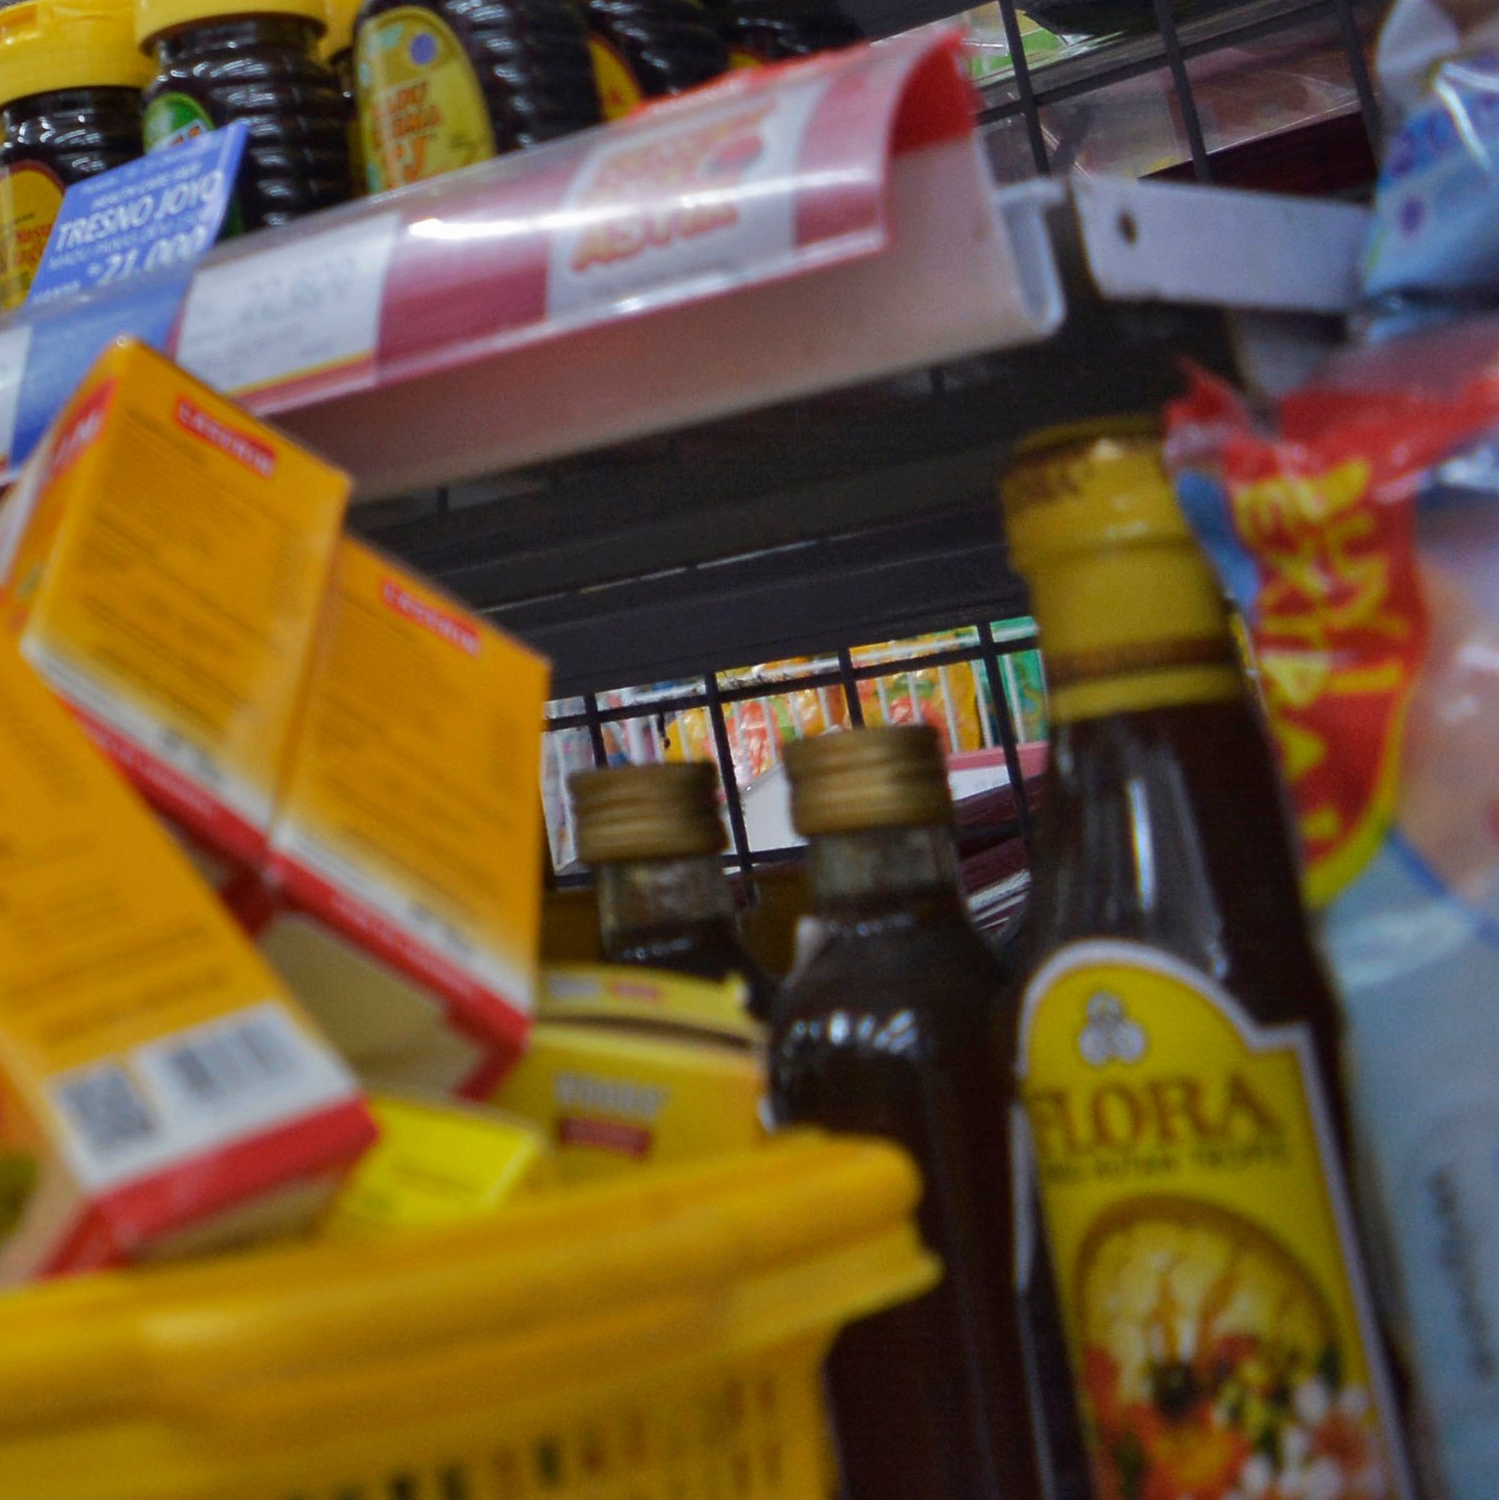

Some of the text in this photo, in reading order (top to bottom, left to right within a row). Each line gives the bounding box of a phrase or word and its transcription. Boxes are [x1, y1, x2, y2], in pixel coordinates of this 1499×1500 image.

[55, 192, 152, 252] TRESNO
[153, 169, 224, 228] JOYO
[100, 224, 207, 286] 21.000
